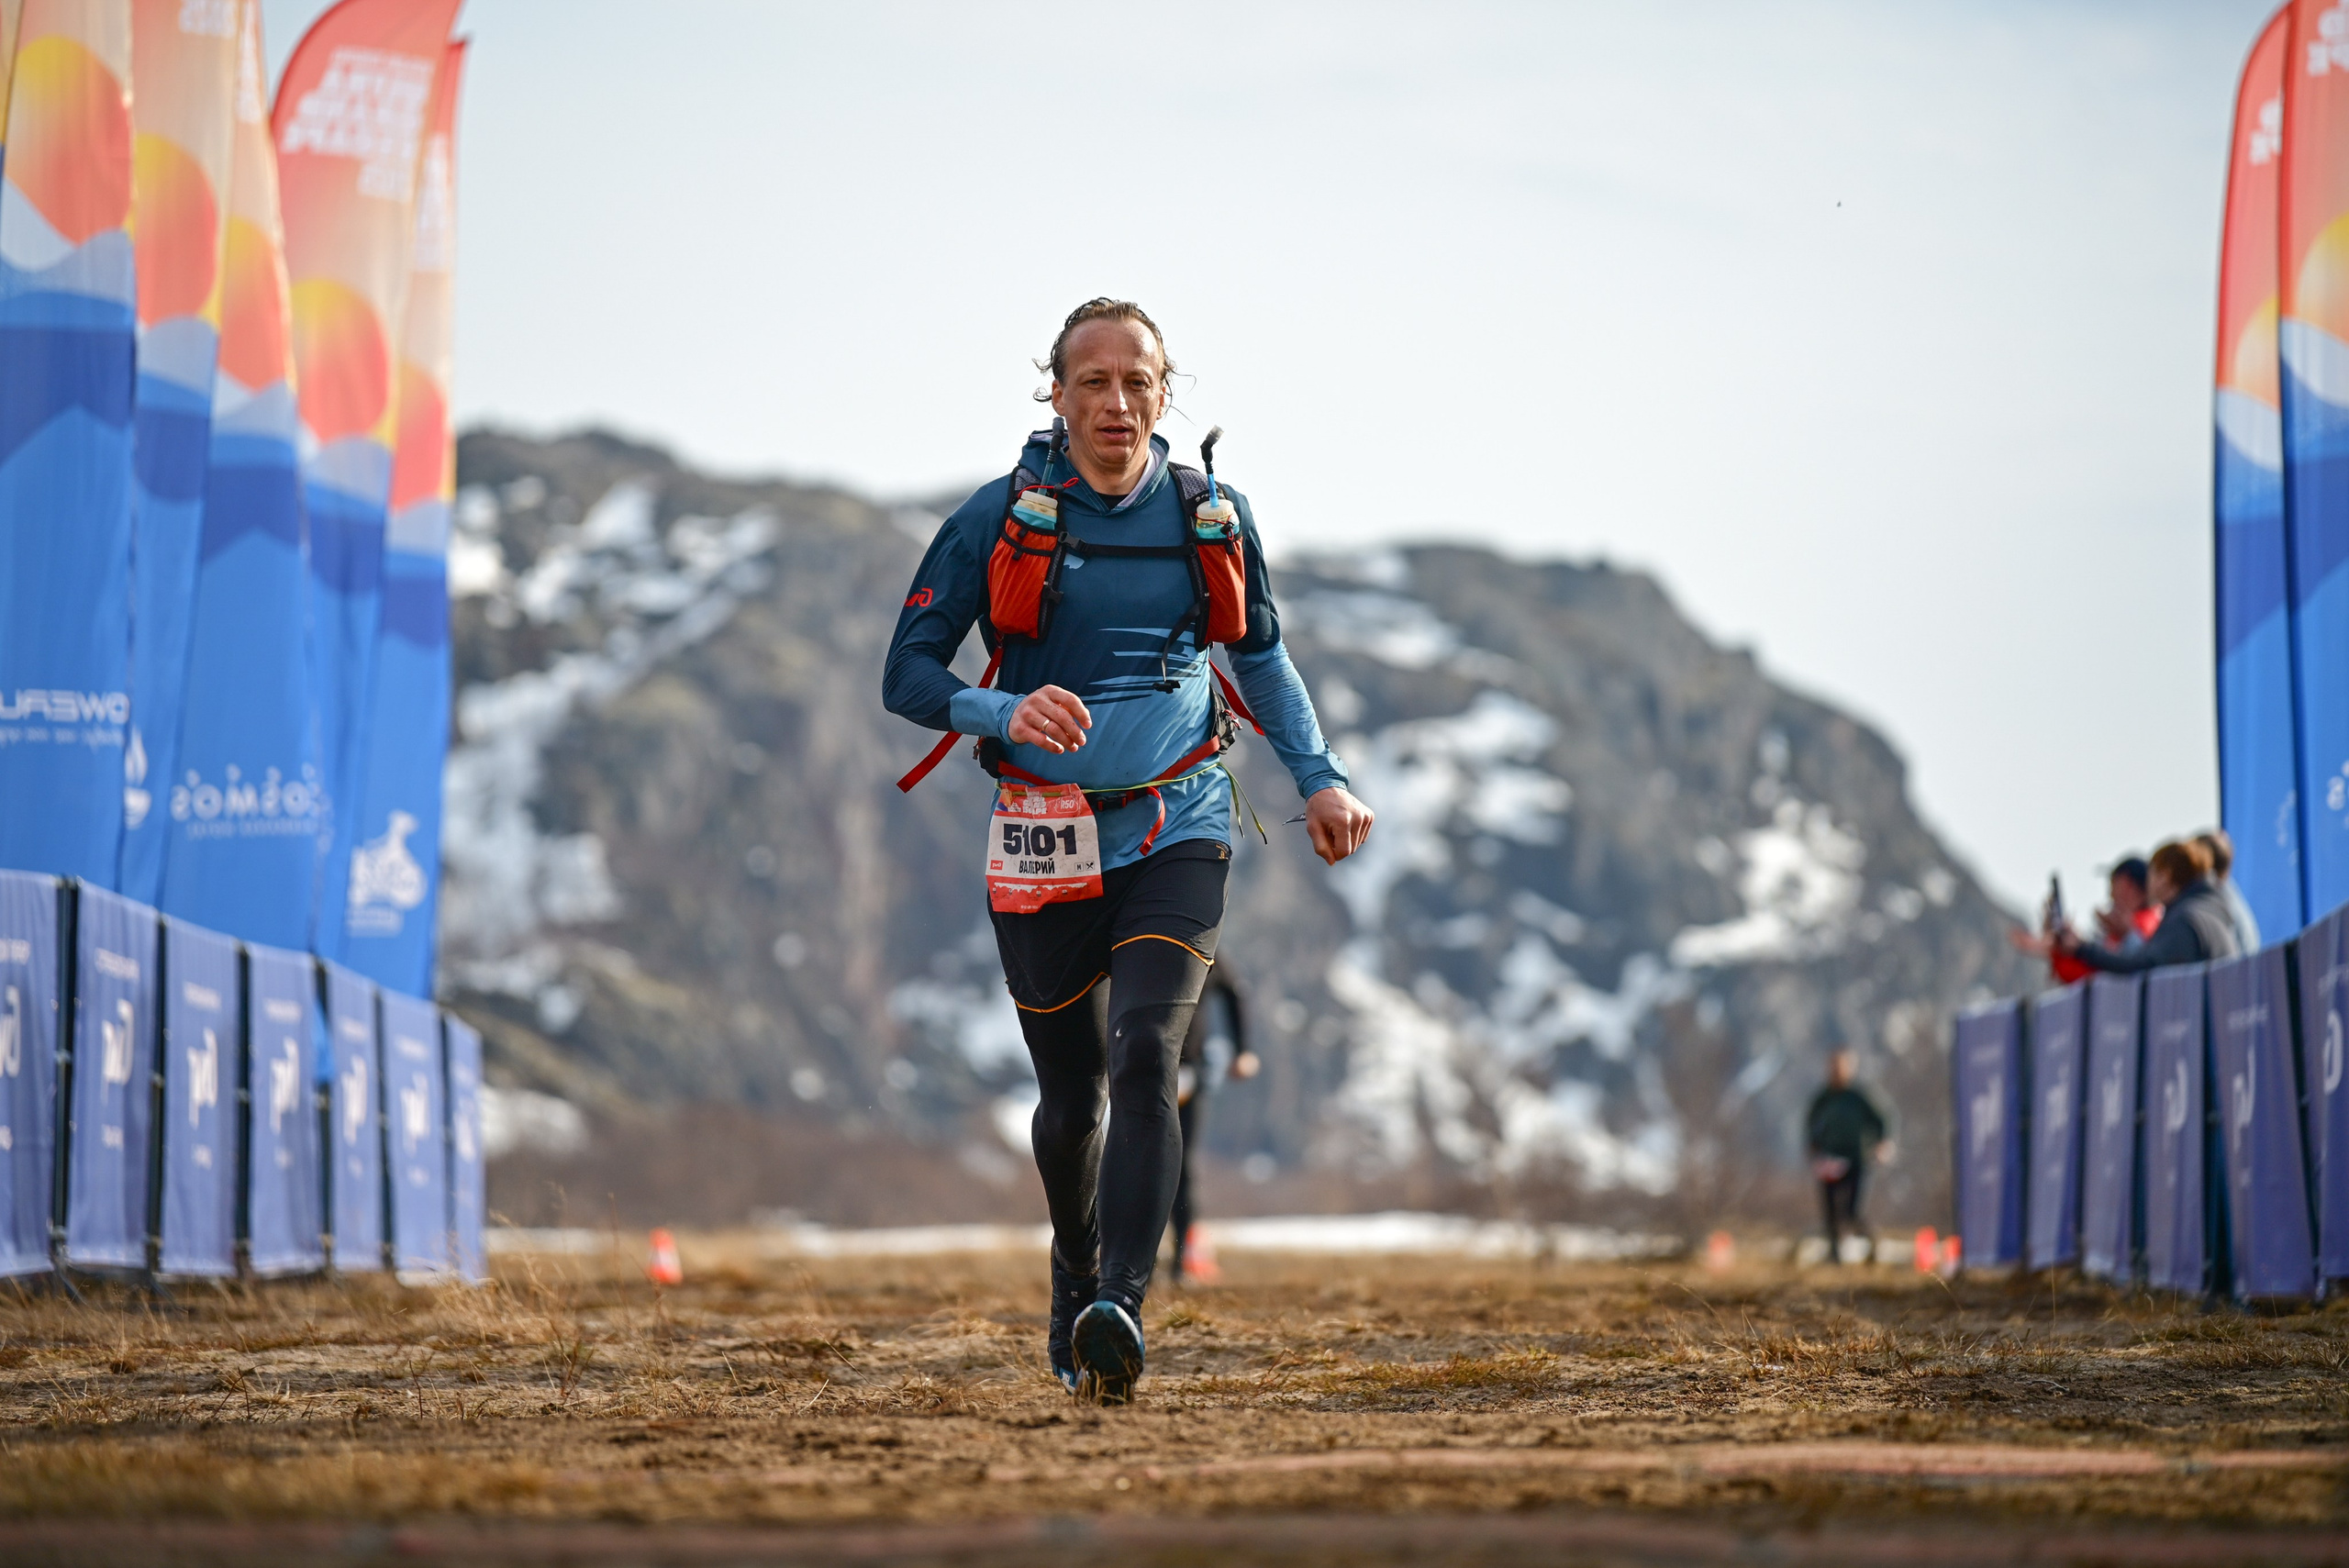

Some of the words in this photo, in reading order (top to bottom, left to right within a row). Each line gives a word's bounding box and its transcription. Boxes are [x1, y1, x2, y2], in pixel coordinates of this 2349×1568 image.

[1061, 800, 1074, 809] R50
[1003, 823, 1077, 857] 5101
[1019, 857, 1055, 874] ВАЛЕРИЙ
